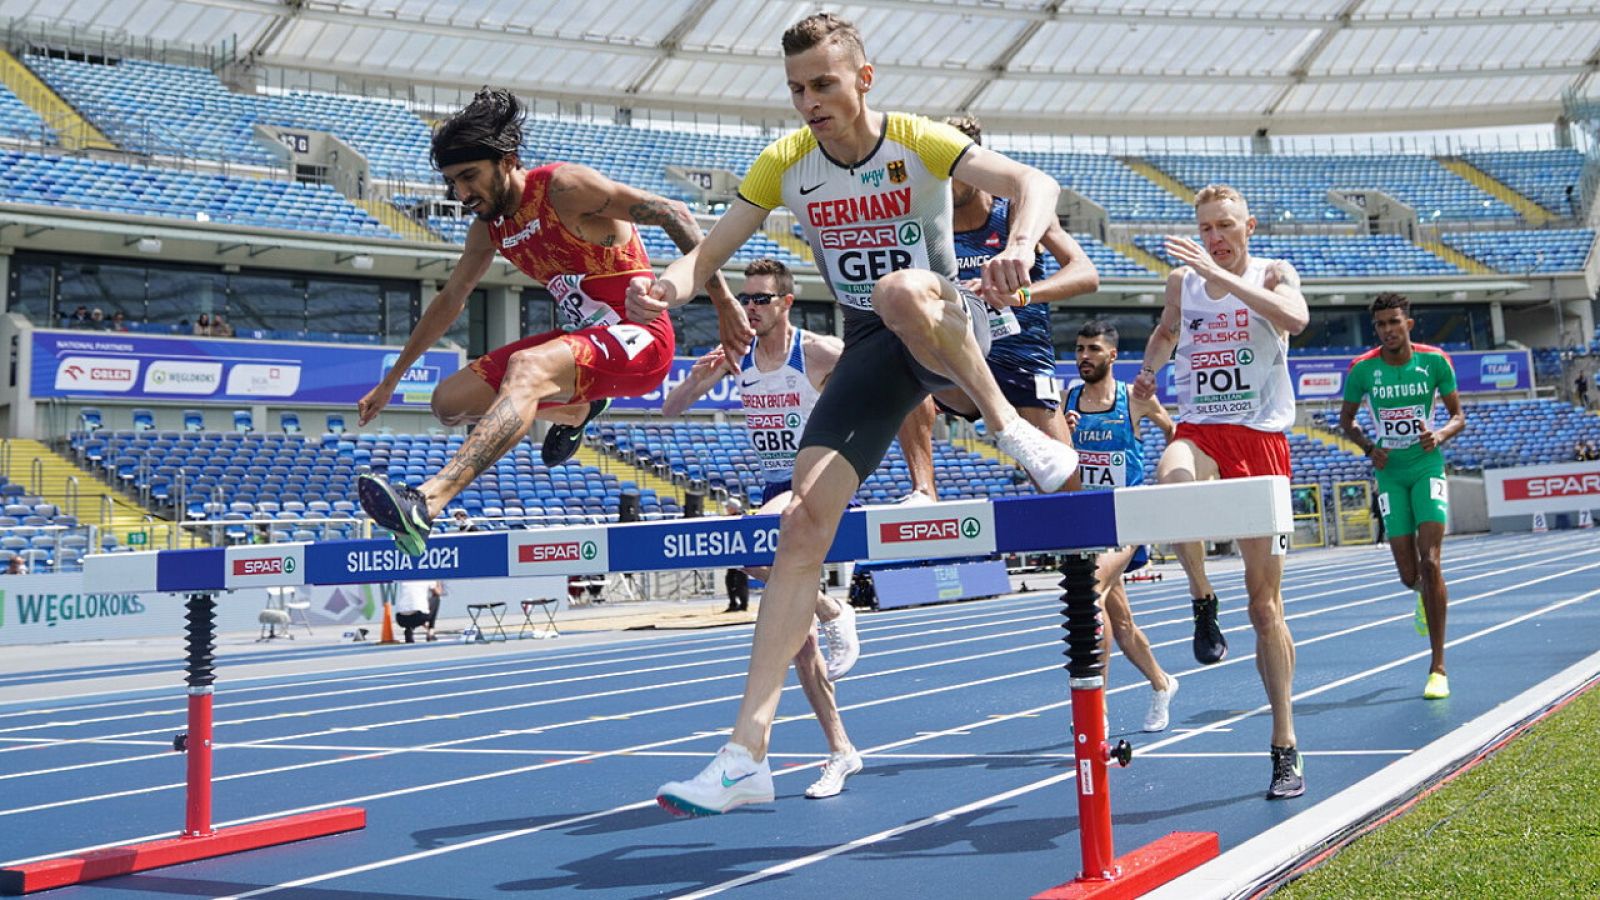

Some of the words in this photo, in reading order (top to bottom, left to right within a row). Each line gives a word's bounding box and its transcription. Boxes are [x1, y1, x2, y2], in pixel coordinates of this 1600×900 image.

[807, 187, 911, 228] GERMANY
[822, 228, 897, 248] SPAR
[1193, 330, 1250, 344] POLSKA
[1192, 351, 1235, 369] SPAR
[1488, 364, 1511, 374] TEAM
[1197, 368, 1251, 395] POL
[1372, 382, 1429, 399] PORTUGAL
[767, 392, 800, 408] BRITAIN
[1229, 401, 1251, 411] 2021
[1380, 409, 1414, 419] SPAR
[1385, 419, 1422, 436] POR
[752, 430, 797, 451] GBR
[1079, 430, 1113, 443] ITALIA
[1080, 454, 1110, 464] PAR
[1080, 466, 1115, 485] ITA
[1527, 475, 1600, 497] SPAR
[1535, 514, 1543, 527] 8
[899, 521, 958, 540] SPAR
[533, 543, 579, 561] SPAR
[663, 532, 748, 558] SILESIA
[753, 529, 780, 553] 20
[244, 558, 281, 573] SPAR
[347, 548, 413, 573] SILESIA
[418, 546, 459, 570] 2021
